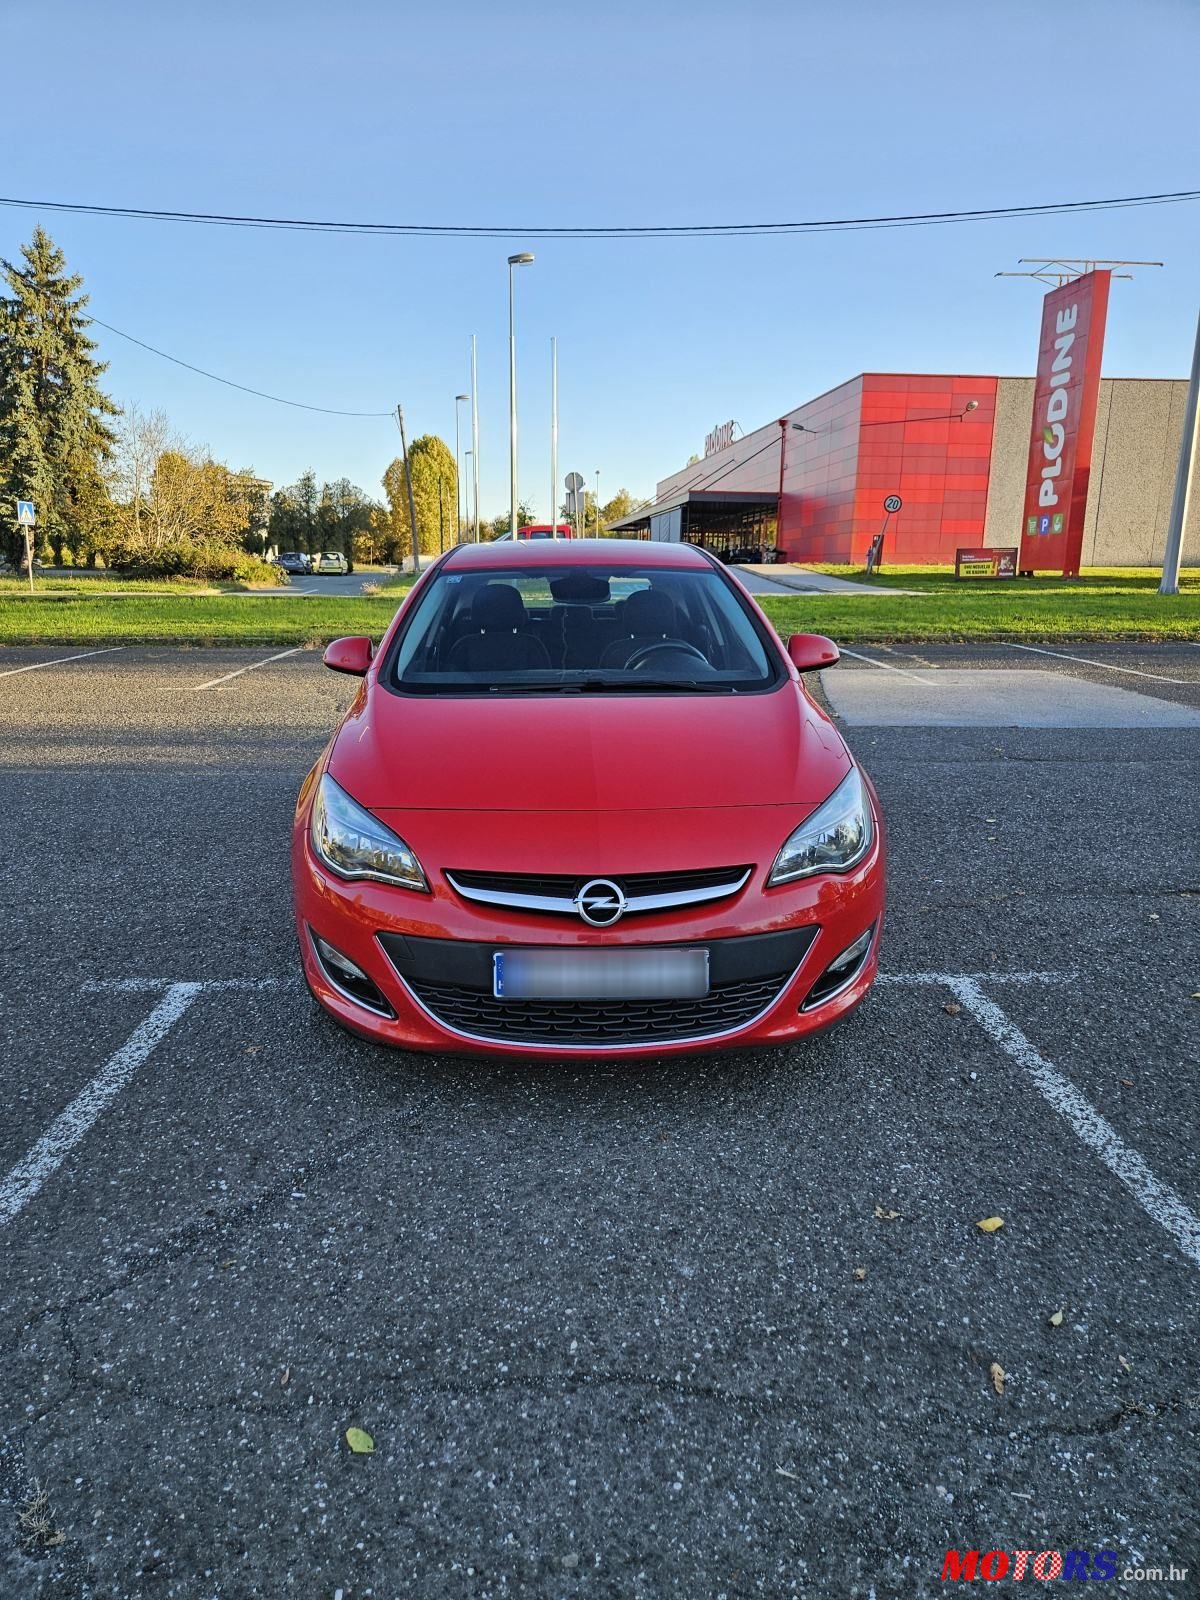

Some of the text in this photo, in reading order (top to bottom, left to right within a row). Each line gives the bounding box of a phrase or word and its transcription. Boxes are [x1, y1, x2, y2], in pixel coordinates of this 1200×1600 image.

[1039, 303, 1078, 507] PLODINE
[887, 498, 899, 510] 20
[1041, 518, 1049, 532] P
